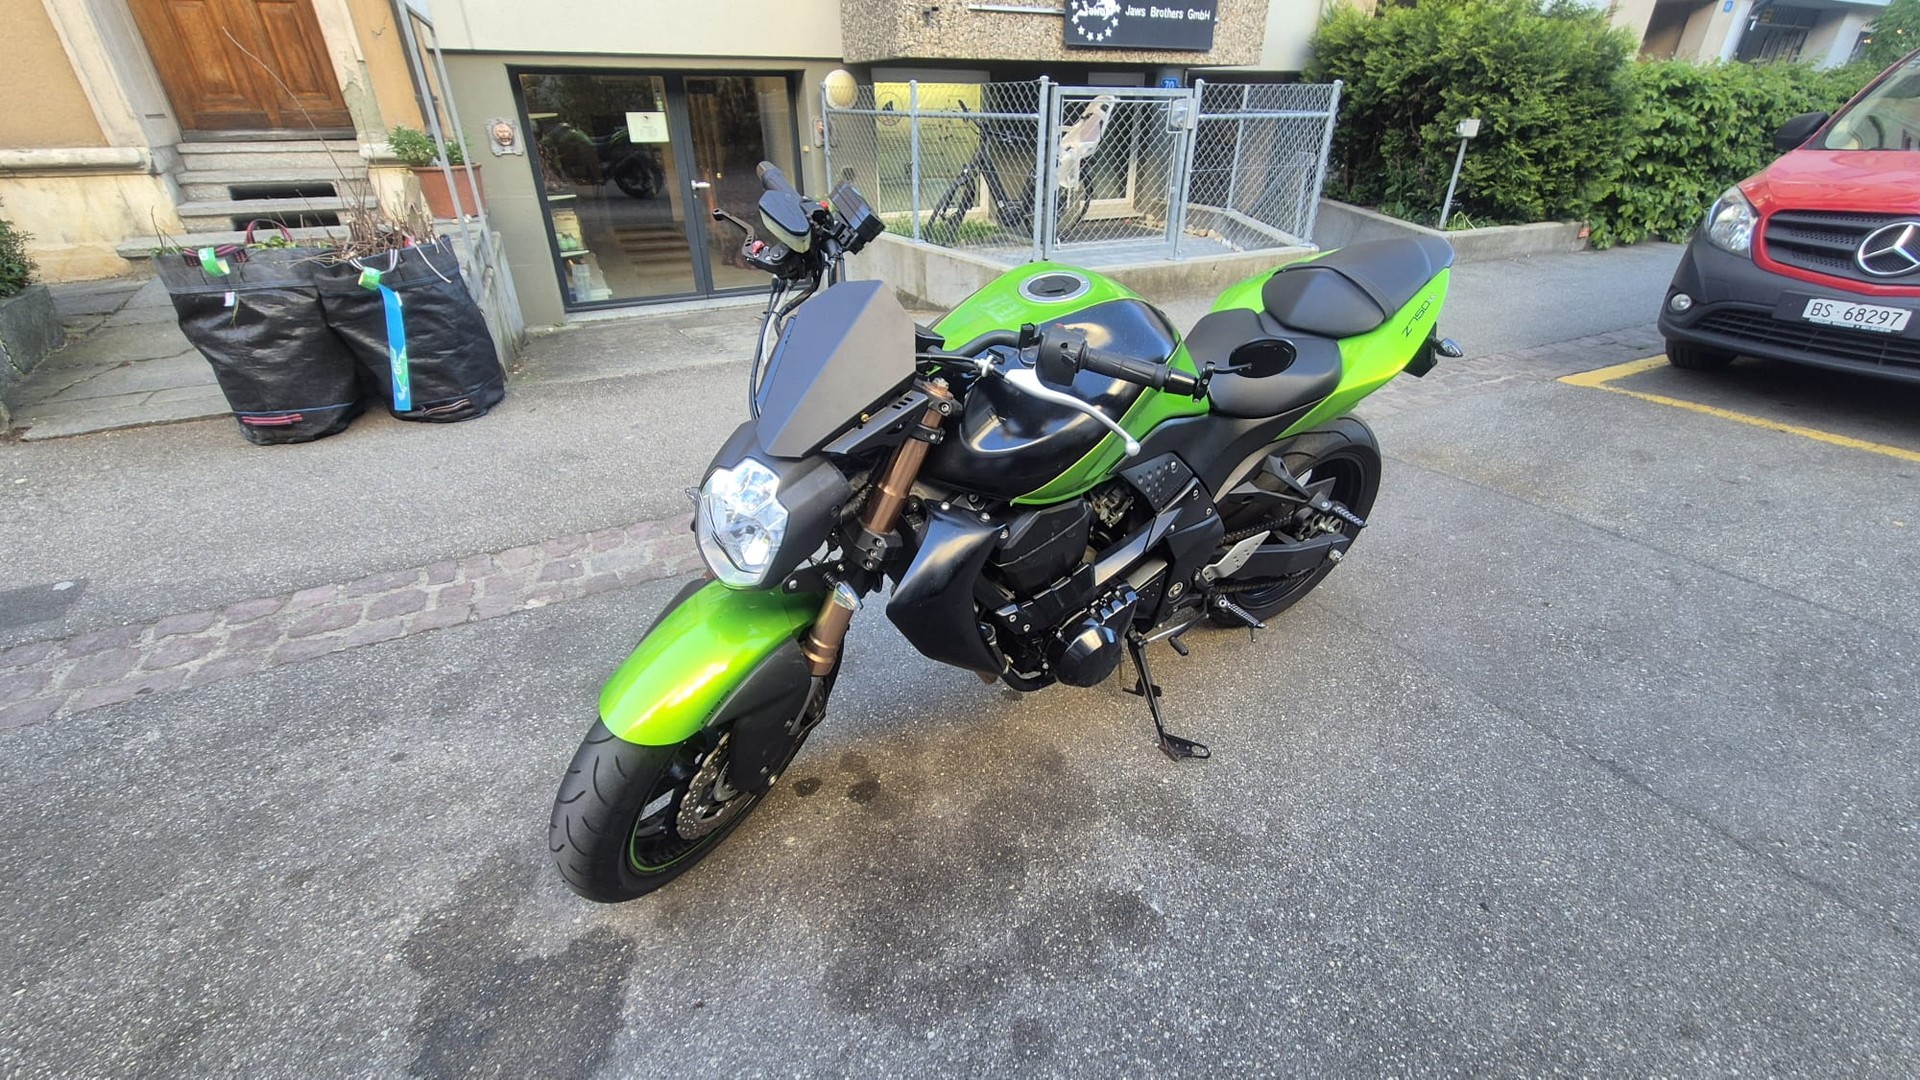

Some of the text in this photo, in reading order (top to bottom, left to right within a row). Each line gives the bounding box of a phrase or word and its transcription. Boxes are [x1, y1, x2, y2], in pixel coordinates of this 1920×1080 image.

[1125, 4, 1211, 20] Jaws Brothers GmbH
[1810, 302, 1834, 318] BS
[1843, 307, 1903, 327] 68297
